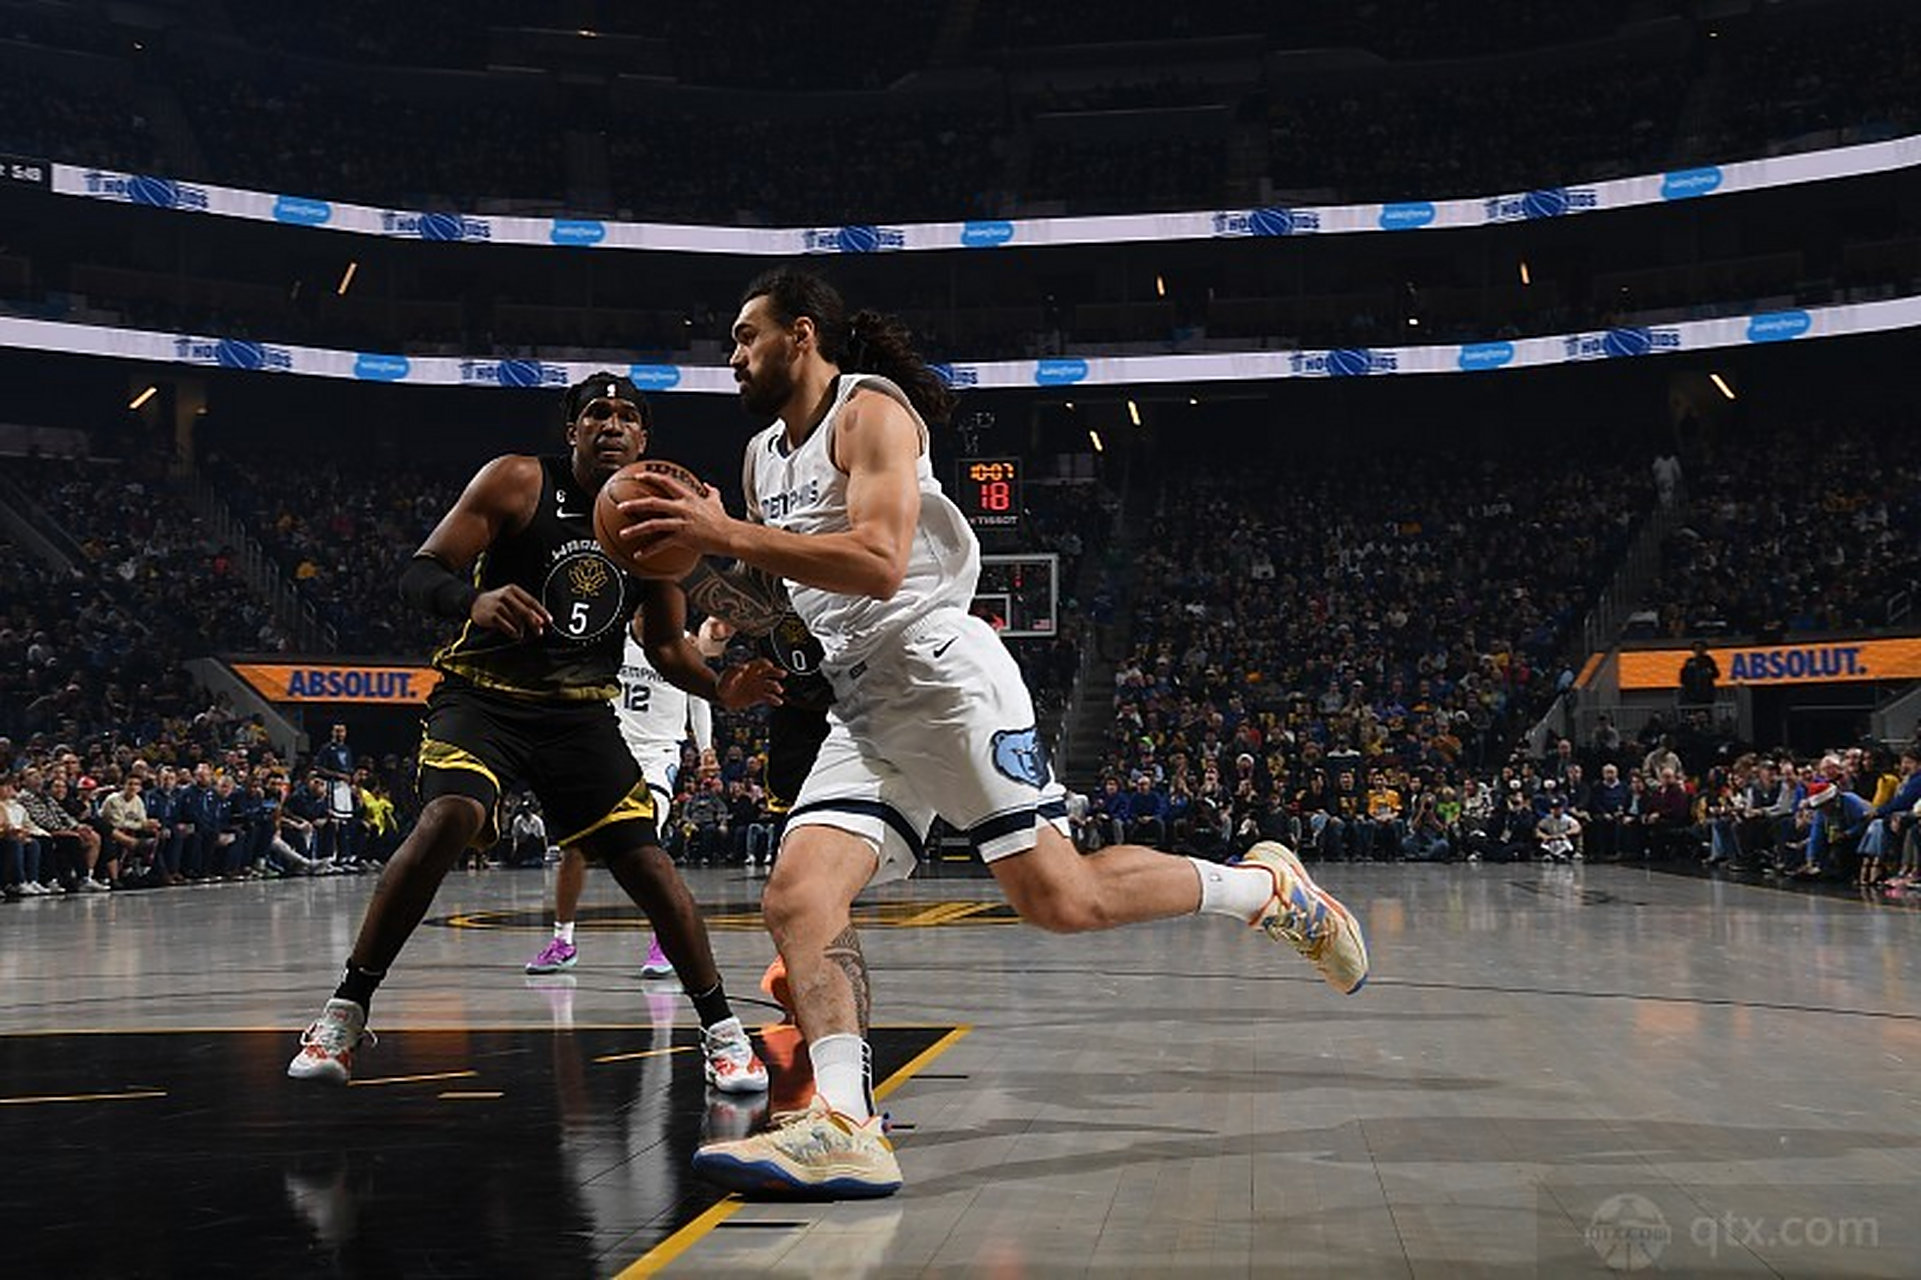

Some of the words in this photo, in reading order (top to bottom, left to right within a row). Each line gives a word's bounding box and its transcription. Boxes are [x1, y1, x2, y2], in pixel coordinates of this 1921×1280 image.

[981, 482, 1010, 510] 18
[568, 601, 591, 635] 5
[791, 650, 808, 671] 0
[1730, 647, 1867, 680] ABSOLUT.
[288, 671, 417, 698] ABSOLUT.
[623, 682, 651, 712] 12
